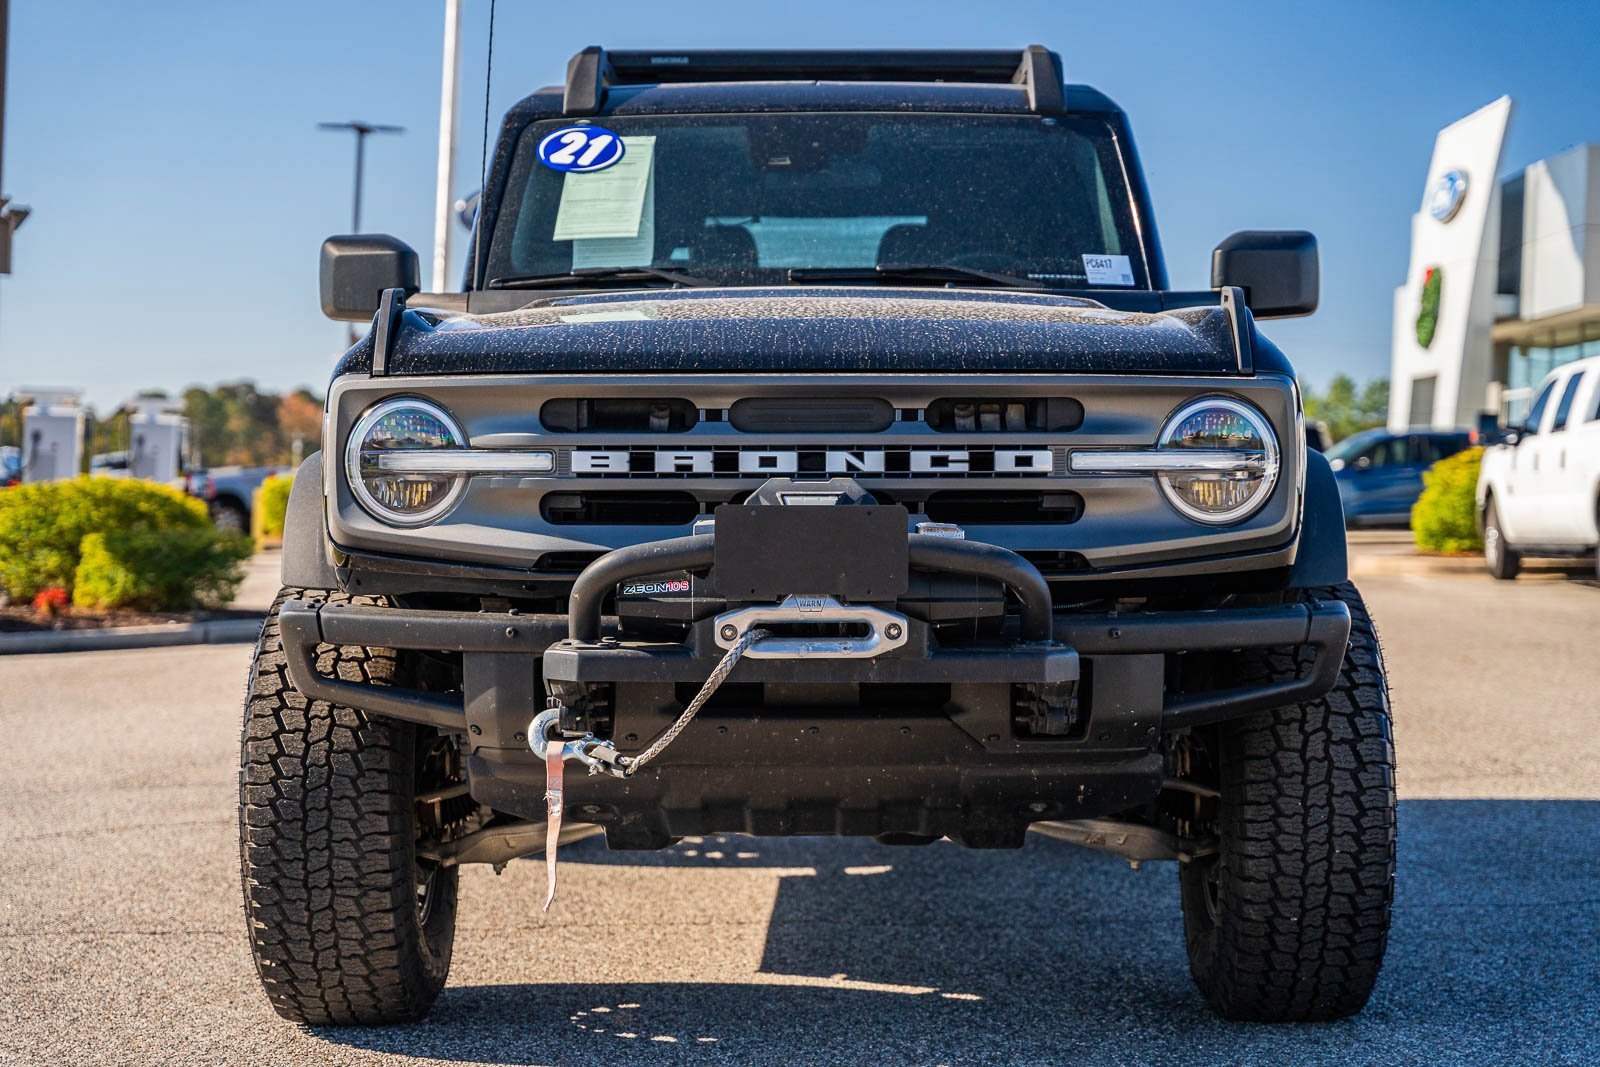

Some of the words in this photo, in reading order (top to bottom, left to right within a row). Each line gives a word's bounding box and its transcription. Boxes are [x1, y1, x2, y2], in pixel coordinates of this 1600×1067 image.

[549, 131, 613, 166] 21
[571, 450, 1053, 473] BRONCO
[799, 599, 822, 607] WARN
